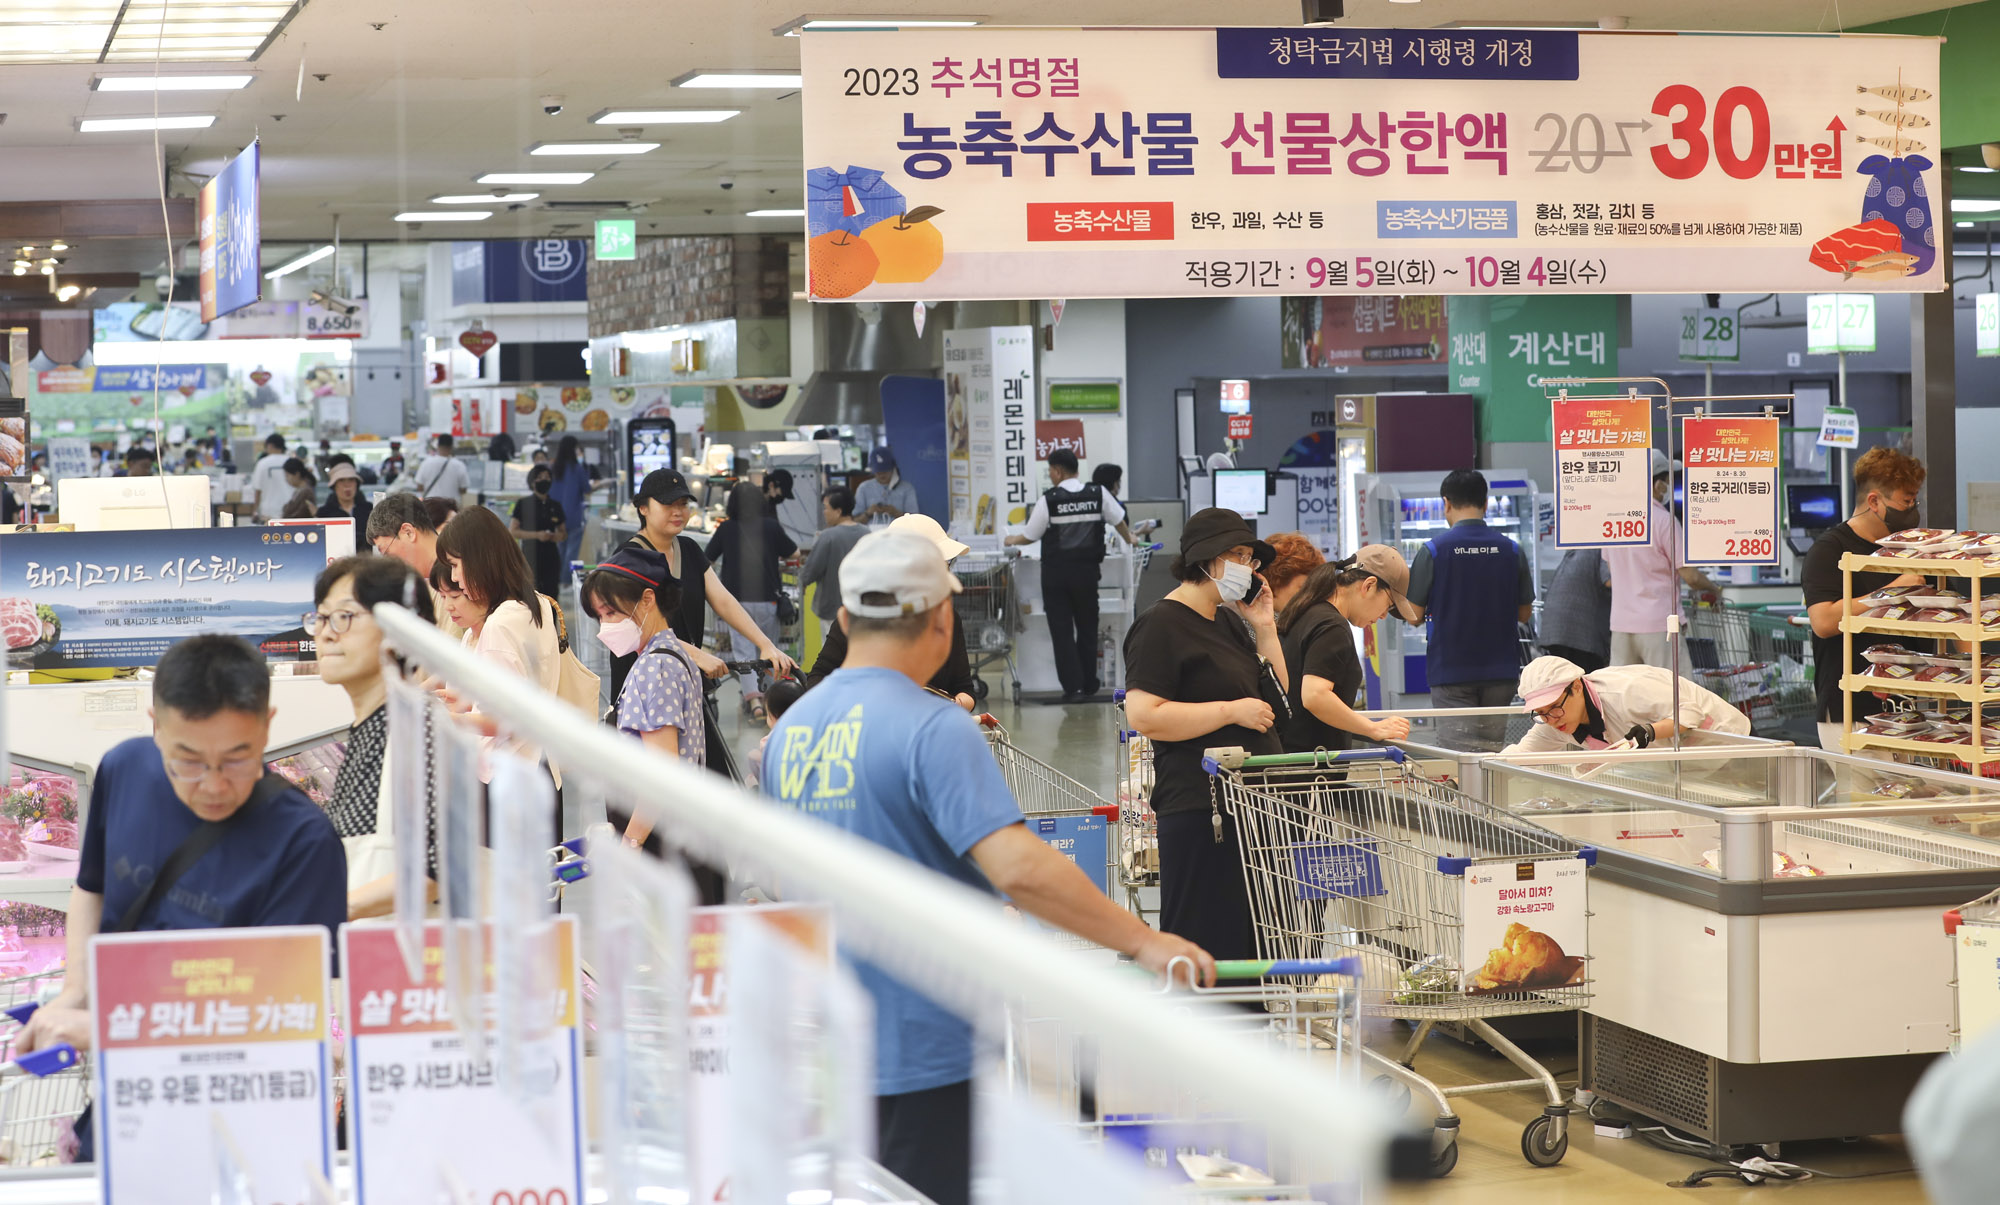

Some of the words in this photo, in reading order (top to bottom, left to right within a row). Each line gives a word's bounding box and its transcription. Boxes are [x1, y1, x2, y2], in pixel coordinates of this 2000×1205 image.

[1268, 36, 1392, 67] 청탁금지법
[1402, 37, 1476, 67] 시행령
[1485, 37, 1533, 67] 개정
[844, 67, 920, 96] 2023
[930, 56, 1080, 98] 추석명절
[896, 111, 1199, 180] 농축수산물
[1221, 111, 1508, 178] 선물상한액
[1053, 209, 1151, 233] 농축수산물
[1190, 211, 1225, 231] 한우,
[1232, 211, 1266, 231] 과일,
[1272, 211, 1302, 230] 수산
[1308, 211, 1324, 230] 등
[1385, 205, 1509, 232] 농축수산가공품
[1536, 202, 1566, 221] 홍삼,
[1573, 203, 1603, 221] 젓갈,
[1609, 203, 1636, 220] 김치
[1642, 203, 1655, 220] 등
[1534, 222, 1589, 238] (농수산물을
[1649, 222, 1681, 238] 50%를
[1683, 222, 1704, 238] 넘게
[1706, 222, 1745, 238] 사용하여
[1747, 222, 1777, 238] 가공한
[1779, 221, 1803, 238] 제품)
[1185, 260, 1281, 288] 적용기간
[1306, 256, 1349, 289] 9월
[1355, 256, 1436, 288] 5일(화)
[1466, 256, 1521, 287] 10월
[1527, 255, 1607, 286] 4일(수)
[1811, 305, 1832, 329] 27
[1842, 304, 1869, 328] 27
[1979, 304, 1997, 331] 26
[1678, 316, 1696, 340] 28
[1702, 316, 1733, 341] 28
[1452, 331, 1486, 365] 계산대
[1508, 331, 1605, 365] 계산대
[1233, 384, 1244, 399] 6
[1459, 374, 1480, 388] Counter
[1230, 420, 1251, 428] CCTV
[1003, 378, 1028, 504] 레몬라테라
[1559, 429, 1575, 445] 살
[1577, 428, 1619, 445] 맛나는
[1620, 429, 1647, 443] 가격!
[1689, 447, 1704, 463] 살
[1706, 447, 1747, 463] 맛나는
[1748, 448, 1774, 463] 가격!
[1561, 460, 1584, 474] 한우
[1587, 460, 1621, 473] 불고기
[1690, 481, 1709, 495] 한우
[1711, 481, 1772, 495] 국거리(1등급)
[1057, 501, 1099, 514] SECURITY
[1626, 510, 1643, 518] 4,980
[1602, 520, 1646, 539] 3,180
[1725, 538, 1772, 557] 2,880
[25, 561, 153, 591] 돼지고기도
[160, 554, 284, 589] 시스템이다
[104, 618, 122, 627] 이제,
[123, 616, 159, 627] 돼지고기도
[161, 614, 206, 625] 시스템입니다.
[1498, 887, 1526, 900] 달아서
[1528, 886, 1553, 898] 미쳐?
[1497, 905, 1511, 915] 강화
[1513, 902, 1554, 913] 속노랑고구마
[360, 989, 397, 1027] 살
[108, 1002, 146, 1042] 살
[150, 999, 250, 1039] 맛나는
[254, 1000, 318, 1034] 가격!
